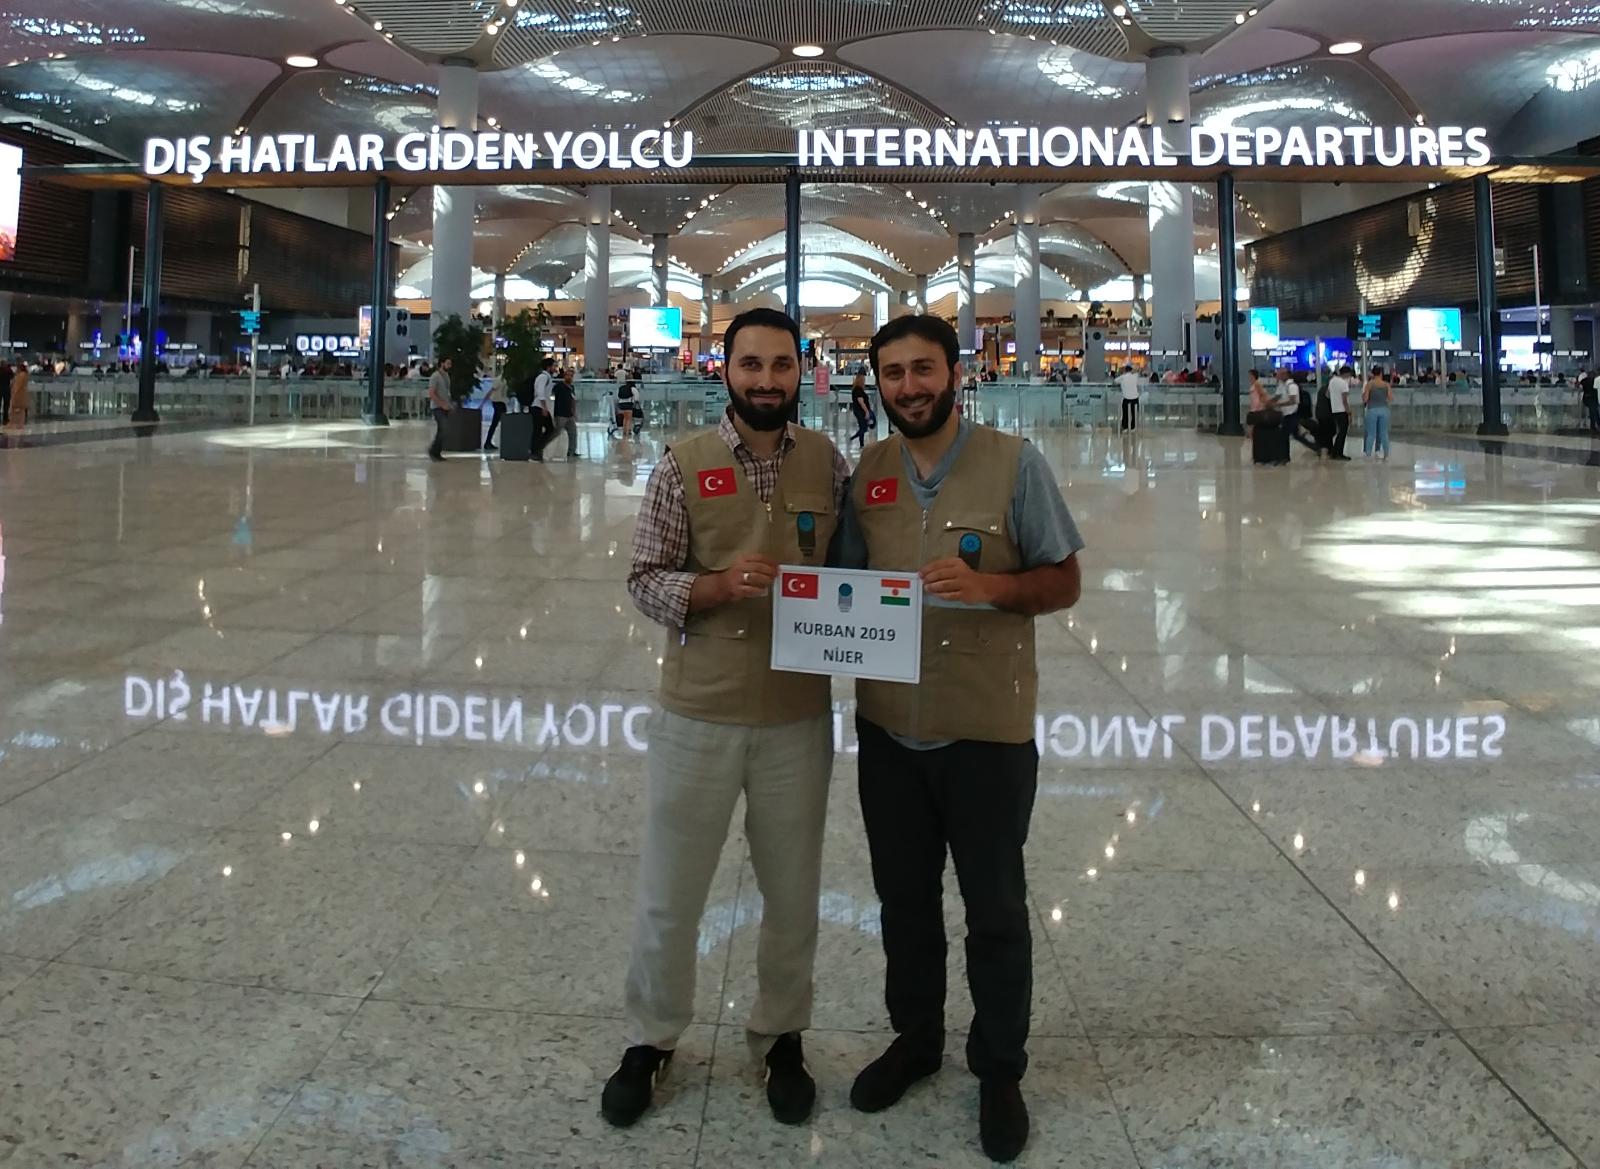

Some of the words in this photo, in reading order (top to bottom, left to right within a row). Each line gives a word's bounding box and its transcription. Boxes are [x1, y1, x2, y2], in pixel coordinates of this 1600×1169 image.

[145, 136, 211, 184] DIŞ
[220, 134, 385, 173] HATLAR
[395, 125, 536, 171] GİDEN
[543, 129, 694, 170] YOLCU
[798, 126, 1178, 167] INTERNATIONAL
[1190, 125, 1492, 167] DEPARTURES
[793, 621, 856, 638] KURBAN
[859, 627, 896, 642] 2019
[823, 647, 864, 664] NİJER
